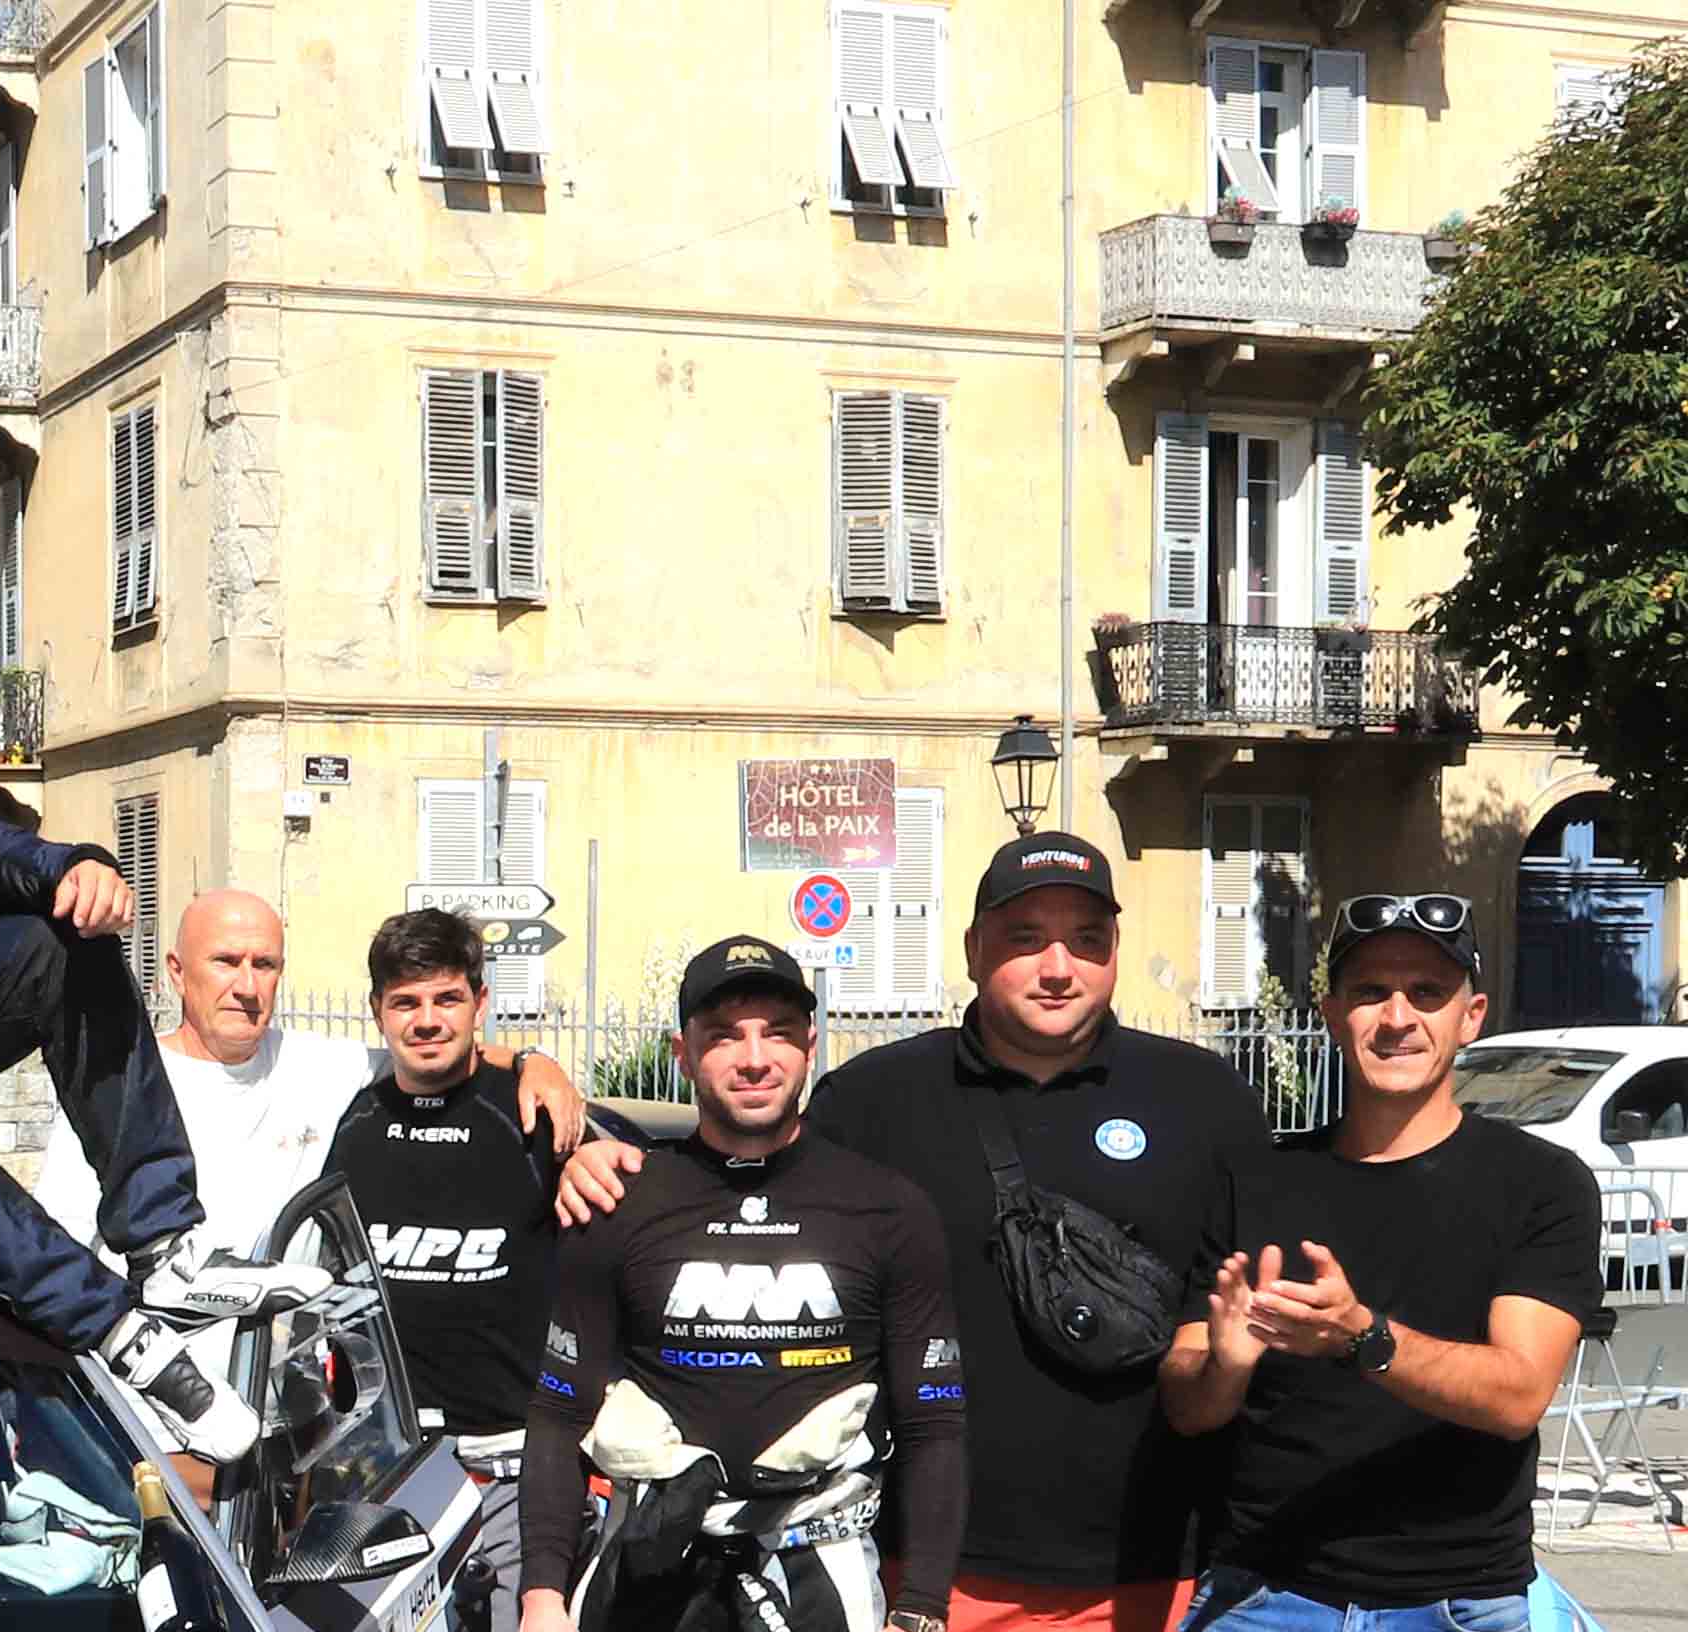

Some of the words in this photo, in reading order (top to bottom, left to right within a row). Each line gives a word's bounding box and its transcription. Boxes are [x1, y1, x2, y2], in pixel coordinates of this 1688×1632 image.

[778, 780, 865, 808] HÔTEL
[764, 816, 792, 837] de
[797, 815, 818, 837] la
[823, 815, 881, 836] PAIX
[410, 1127, 470, 1143] KERN
[663, 1325, 688, 1337] AM
[693, 1324, 846, 1339] ENVIRONNEMENT
